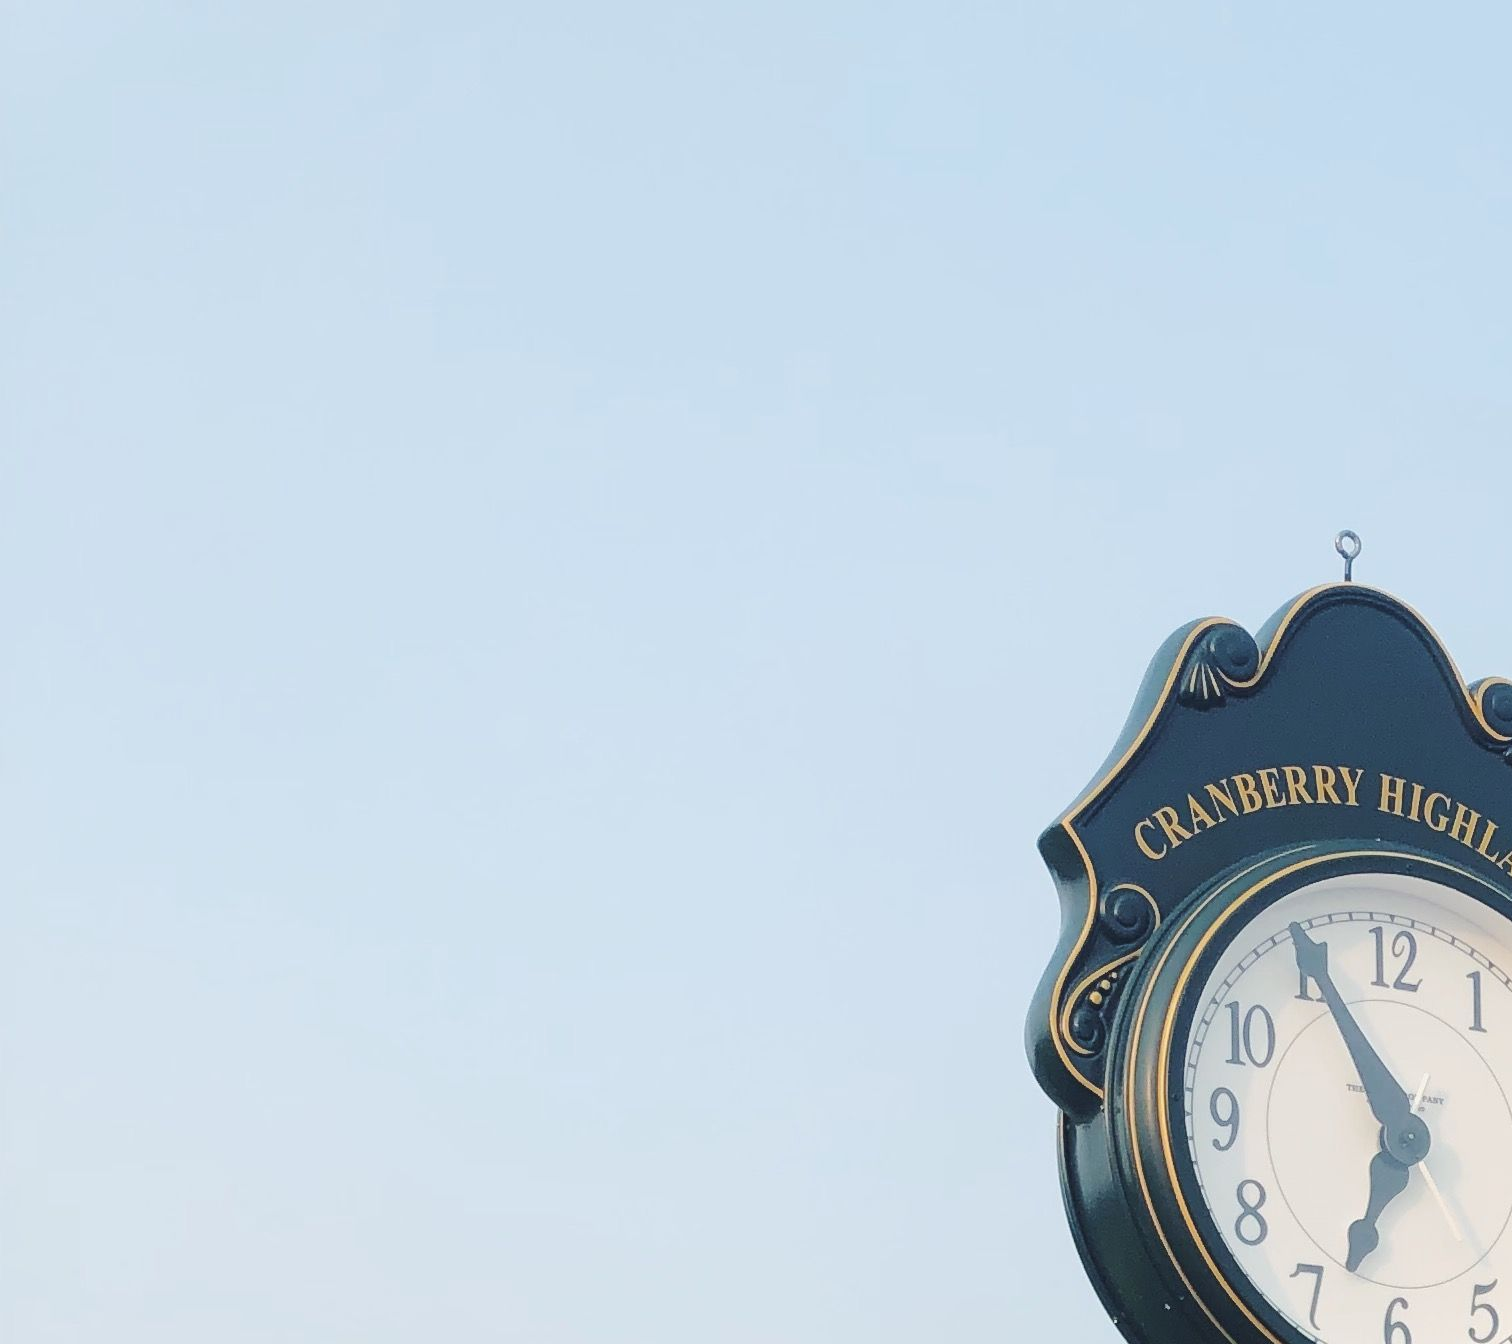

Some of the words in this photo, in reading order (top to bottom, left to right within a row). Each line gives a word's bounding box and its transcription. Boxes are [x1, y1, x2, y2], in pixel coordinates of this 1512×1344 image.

[1134, 764, 1364, 860] CRANBERRY
[1369, 926, 1424, 992] 12
[1224, 1000, 1276, 1068] 10
[1466, 970, 1488, 1033] 1
[1209, 1086, 1240, 1151] 9
[1234, 1179, 1269, 1246] 8
[1289, 1263, 1325, 1331] 7
[1468, 1279, 1500, 1344] 5
